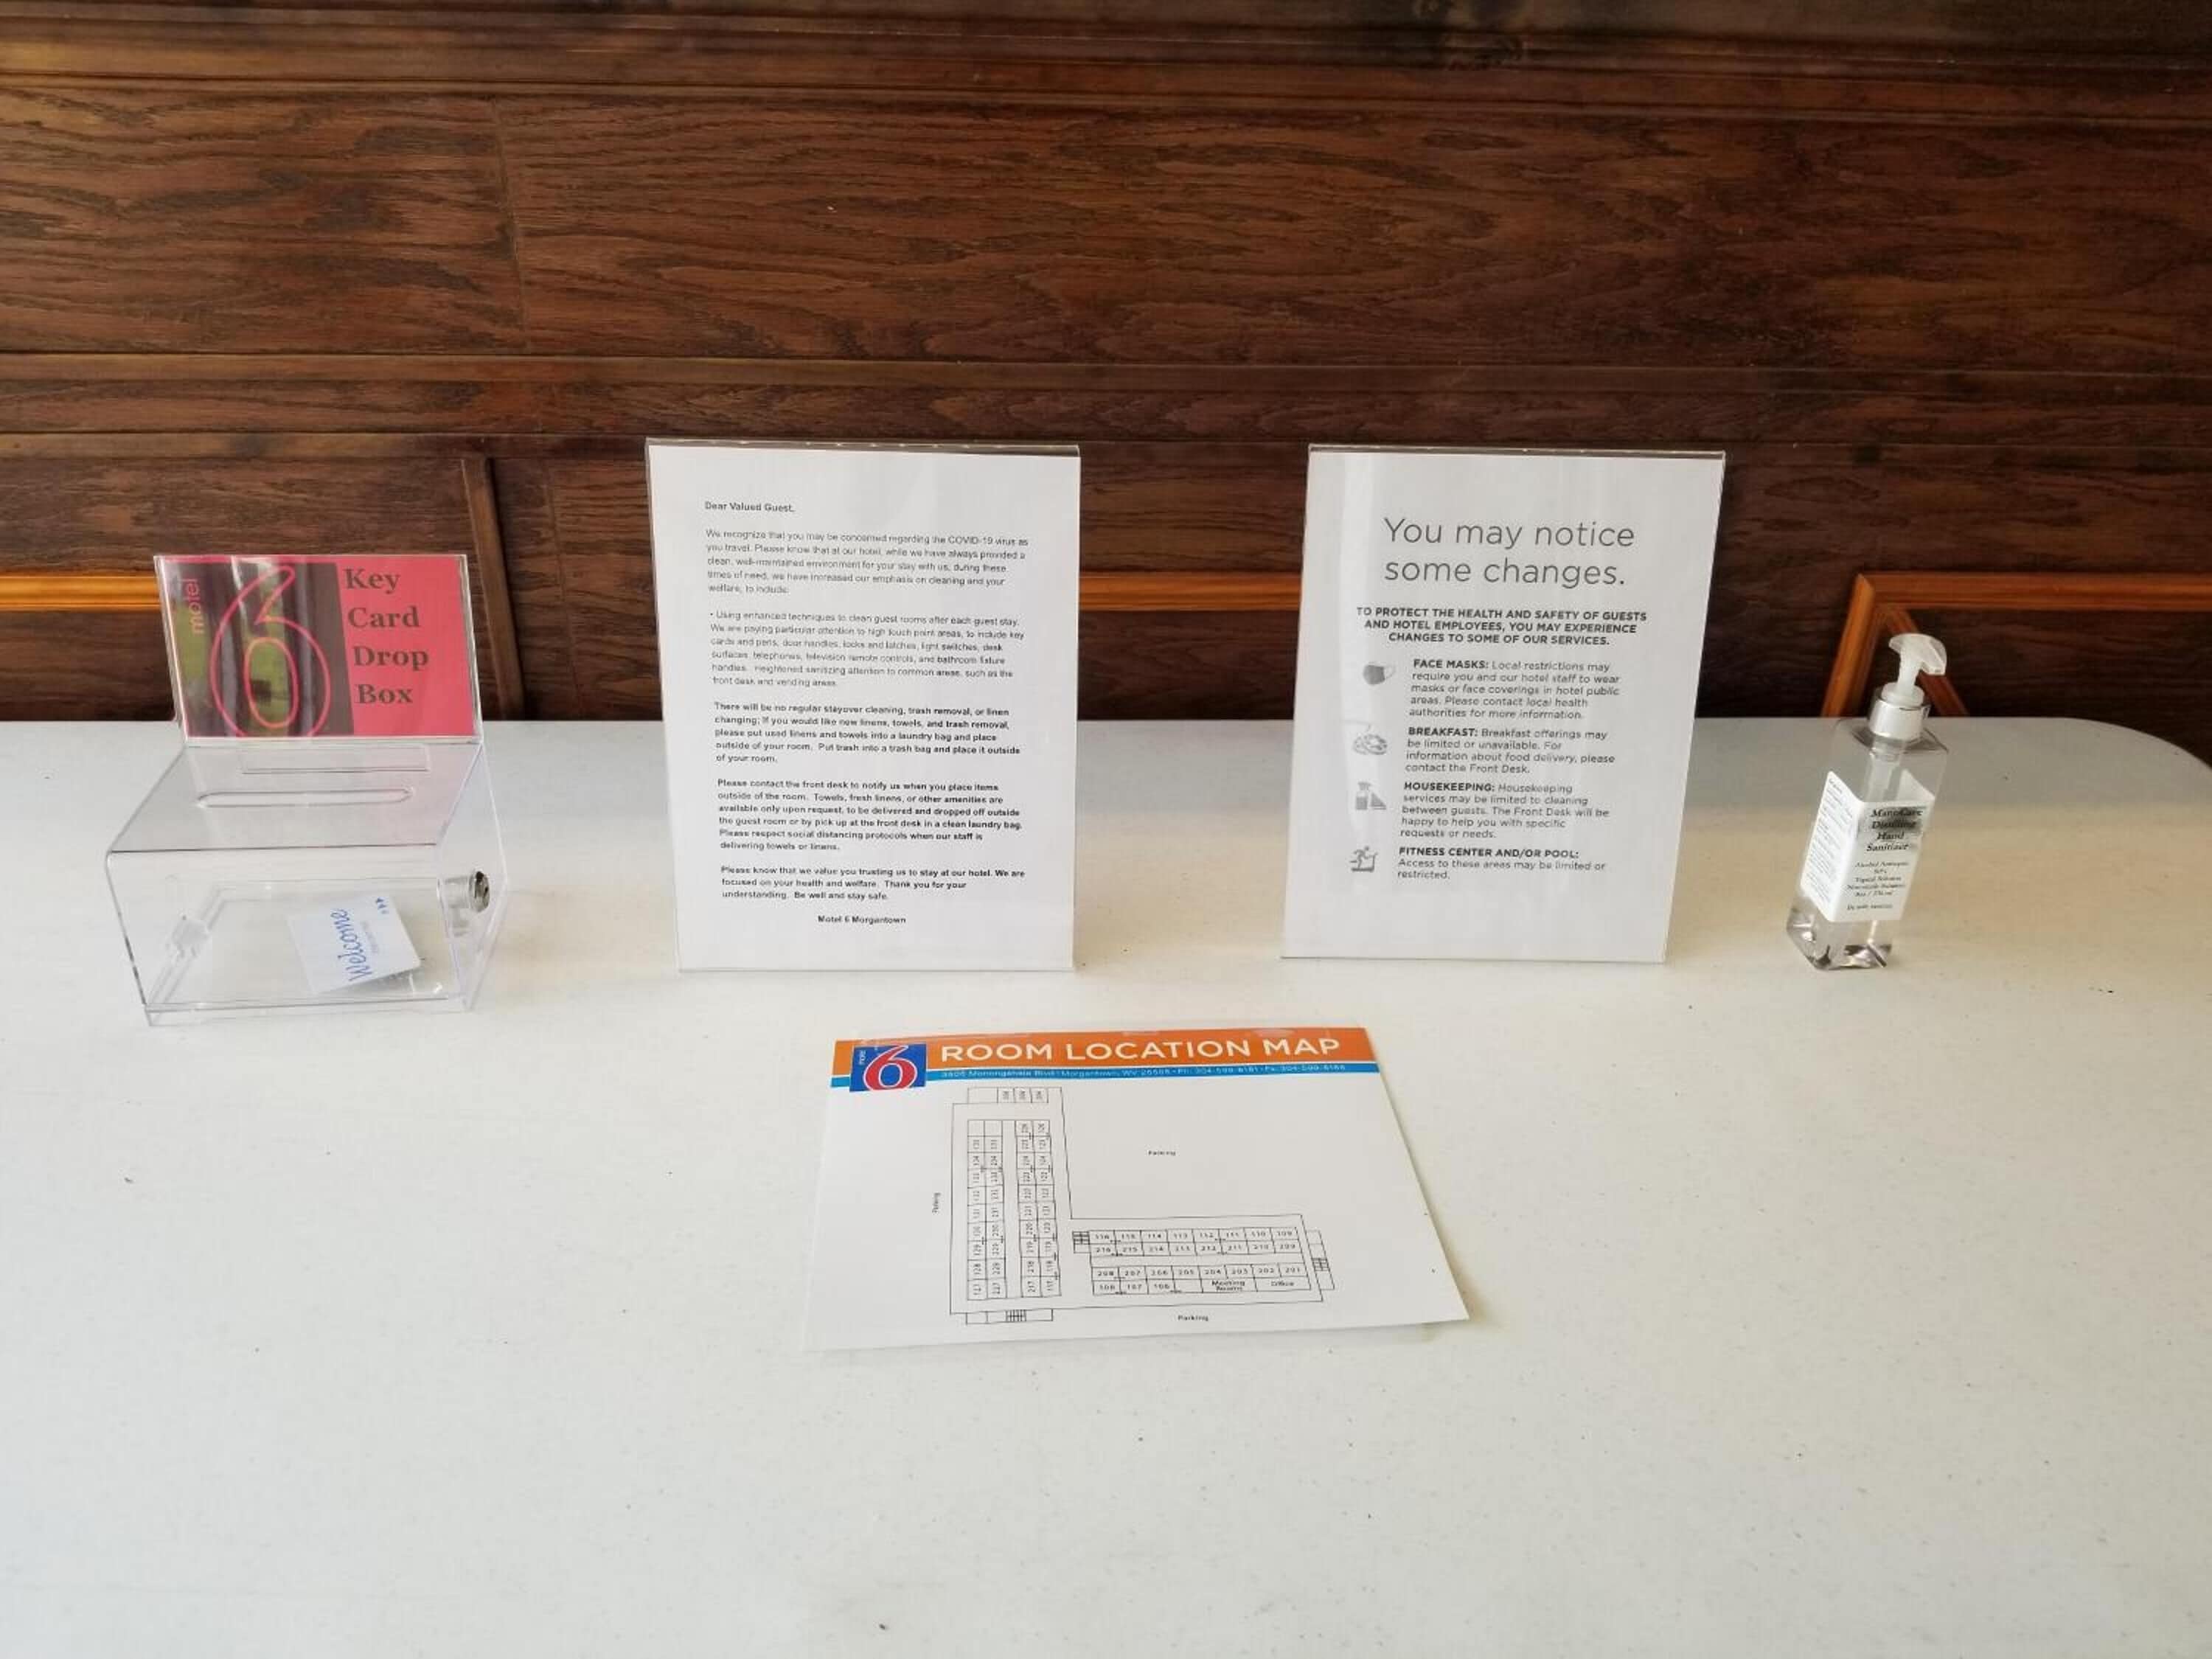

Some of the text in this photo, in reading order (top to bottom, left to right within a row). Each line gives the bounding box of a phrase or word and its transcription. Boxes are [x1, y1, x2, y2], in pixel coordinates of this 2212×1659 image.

[704, 501, 727, 509] Dear
[729, 502, 762, 511] Valued
[1384, 518, 1634, 550] You may notice
[1385, 557, 1625, 590] some changes.
[343, 568, 399, 594] Key
[181, 578, 204, 634] motel
[348, 606, 419, 627] Card
[1357, 607, 1646, 621] TO PROTECT THE HEALTH AND SAFETY OF GUESTS
[1365, 619, 1637, 633] AND HOTEL EMPLOYEES, YOU MAY EXPERIENCE
[1388, 632, 1609, 645] CHANGES TO SOME OF OUR SERVICES.
[210, 566, 330, 737] 6
[353, 646, 428, 670] Drop
[1413, 658, 1610, 672] FACE MASKS: Local restrictions may
[1454, 674, 1473, 682] you
[1521, 673, 1548, 682] hotel
[1552, 673, 1576, 683] staff
[1579, 675, 1590, 684] to
[358, 684, 412, 704] Box
[1462, 684, 1485, 693] face
[1488, 686, 1539, 695] coverings
[1556, 686, 1583, 695] hotel
[1586, 686, 1619, 697] public
[1444, 695, 1479, 705] Please
[1526, 698, 1551, 707] local
[1555, 698, 1588, 706] health
[1409, 708, 1467, 717] authorities
[1470, 709, 1486, 717] for
[1408, 727, 1607, 740] BREAKFAST: Breakfast offerings may
[1407, 739, 1420, 748] be
[1478, 740, 1540, 750] unavailable.
[1544, 741, 1561, 750] For
[1406, 751, 1615, 764] information about food delivery, please
[1470, 764, 1498, 773] Front
[1501, 765, 1529, 773] Desk.
[1404, 782, 1572, 794] HOUSEKEEPING: Housekeeping
[1399, 846, 1579, 858] FITNESS CENTER AND/OR POOL:
[1397, 858, 1434, 867] Access
[1452, 860, 1480, 868] these
[1514, 862, 1535, 870] may
[1539, 860, 1552, 869] be
[1555, 861, 1592, 870] limited
[1397, 870, 1450, 879] restricted.
[852, 916, 906, 925] Morgantown
[330, 908, 372, 981] Welcome
[942, 1037, 1339, 1062] ROOM LOCATION MAP
[863, 1045, 917, 1091] 6
